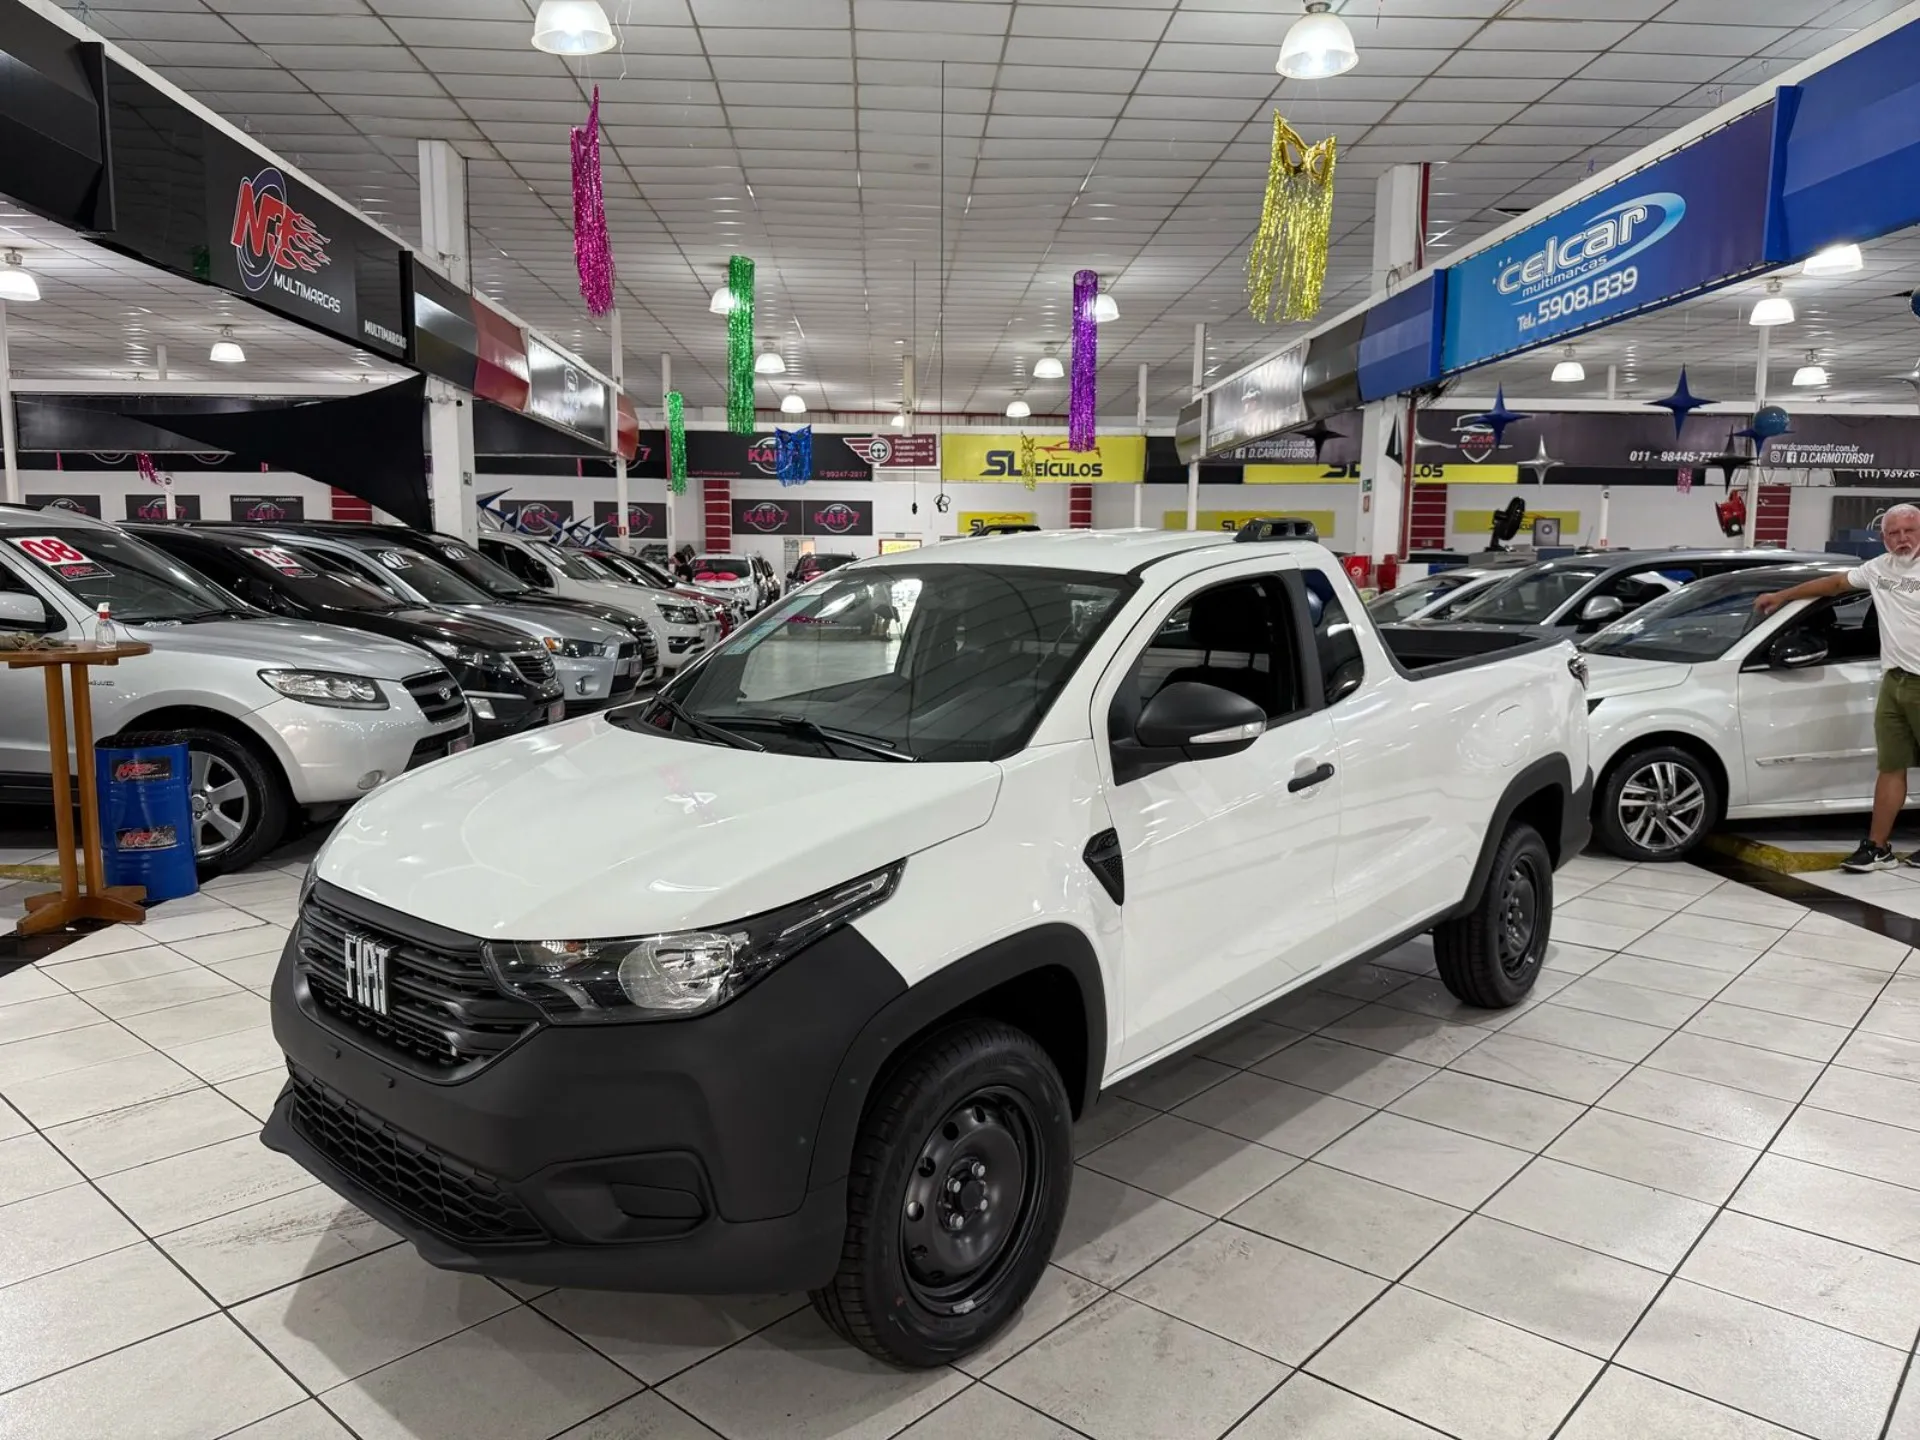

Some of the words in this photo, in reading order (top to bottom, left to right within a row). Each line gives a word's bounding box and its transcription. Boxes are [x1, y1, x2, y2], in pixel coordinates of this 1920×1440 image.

[1496, 204, 1648, 295] celcar
[1521, 253, 1609, 298] multimarcas
[273, 270, 342, 314] MULTIMARCAS
[1537, 264, 1638, 325] 5908.1339
[979, 449, 1024, 477] SL
[1034, 458, 1104, 478] EÍCULOS
[1629, 450, 1651, 462] 011
[1799, 452, 1875, 465] D.CARMOTORS01
[743, 510, 777, 523] KAR
[814, 511, 849, 525] KAR
[19, 539, 85, 563] 08
[344, 932, 390, 1015] FIAT
